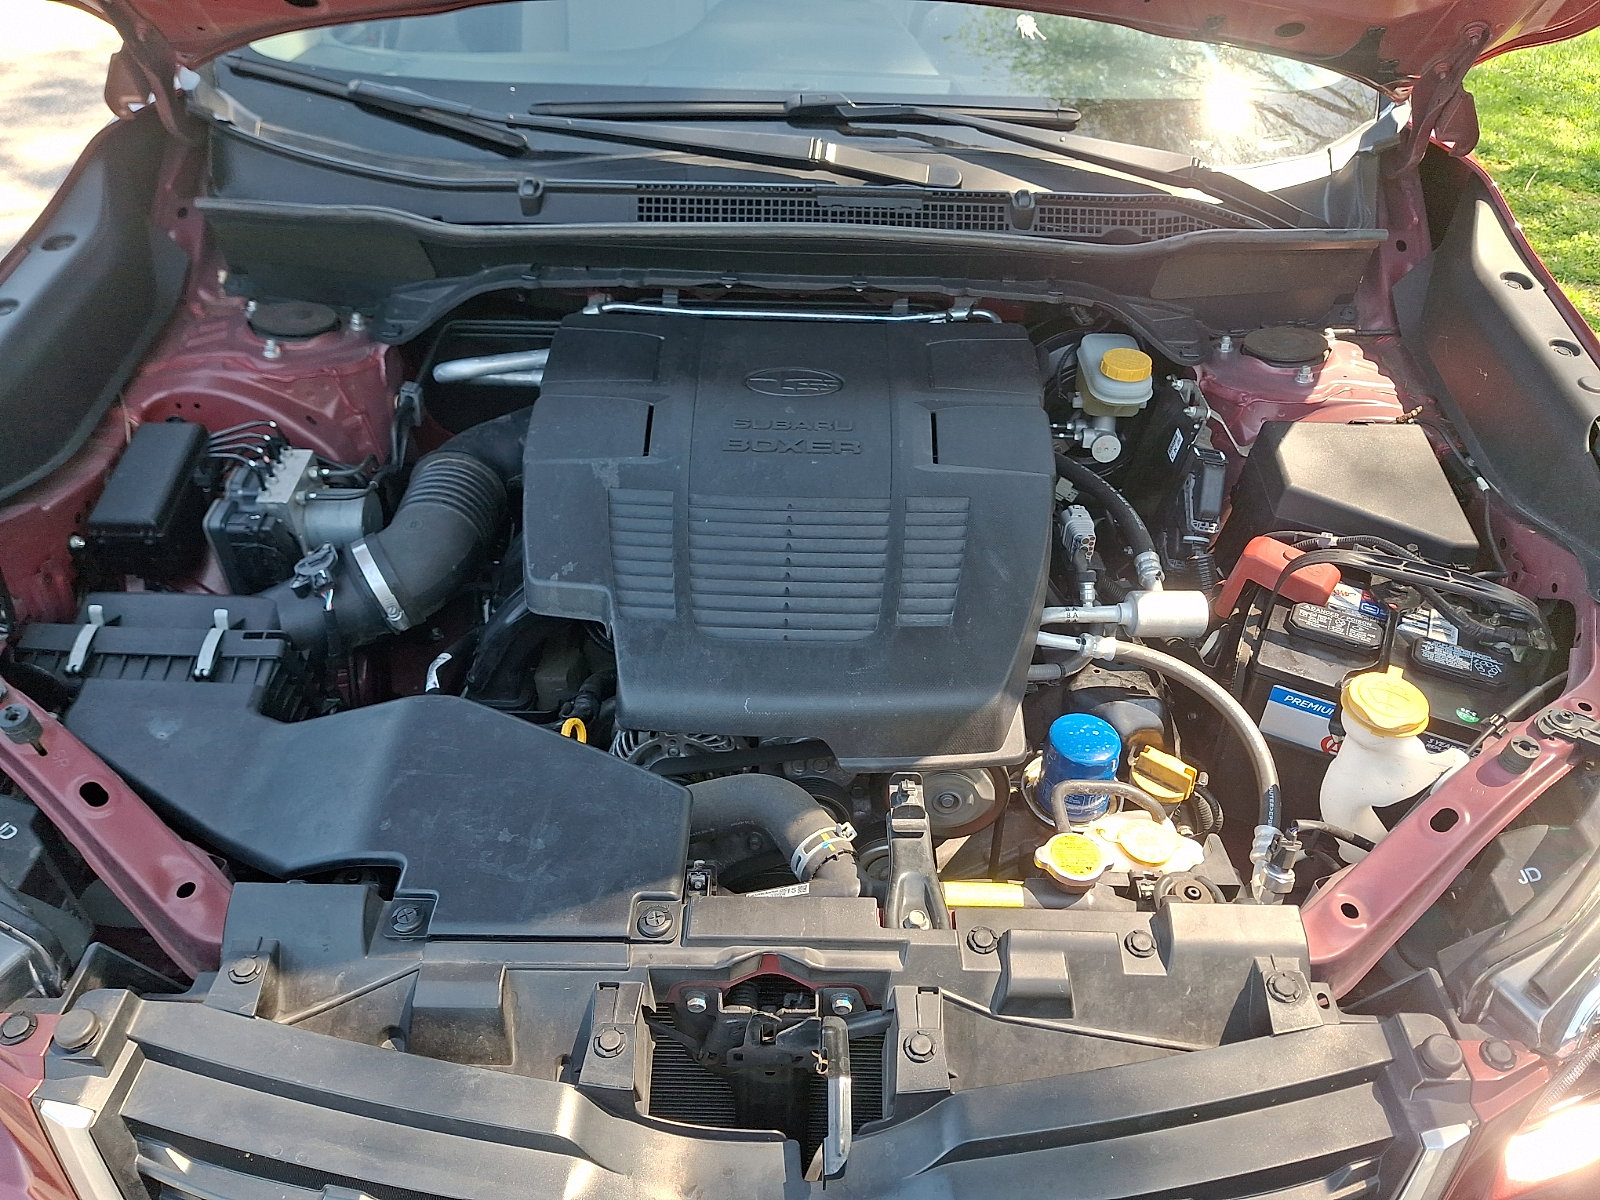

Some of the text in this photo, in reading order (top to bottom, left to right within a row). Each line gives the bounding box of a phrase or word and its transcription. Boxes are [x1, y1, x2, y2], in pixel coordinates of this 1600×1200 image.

[732, 419, 853, 432] SUBARU
[722, 439, 863, 454] BOXER
[1517, 867, 1542, 885] JD
